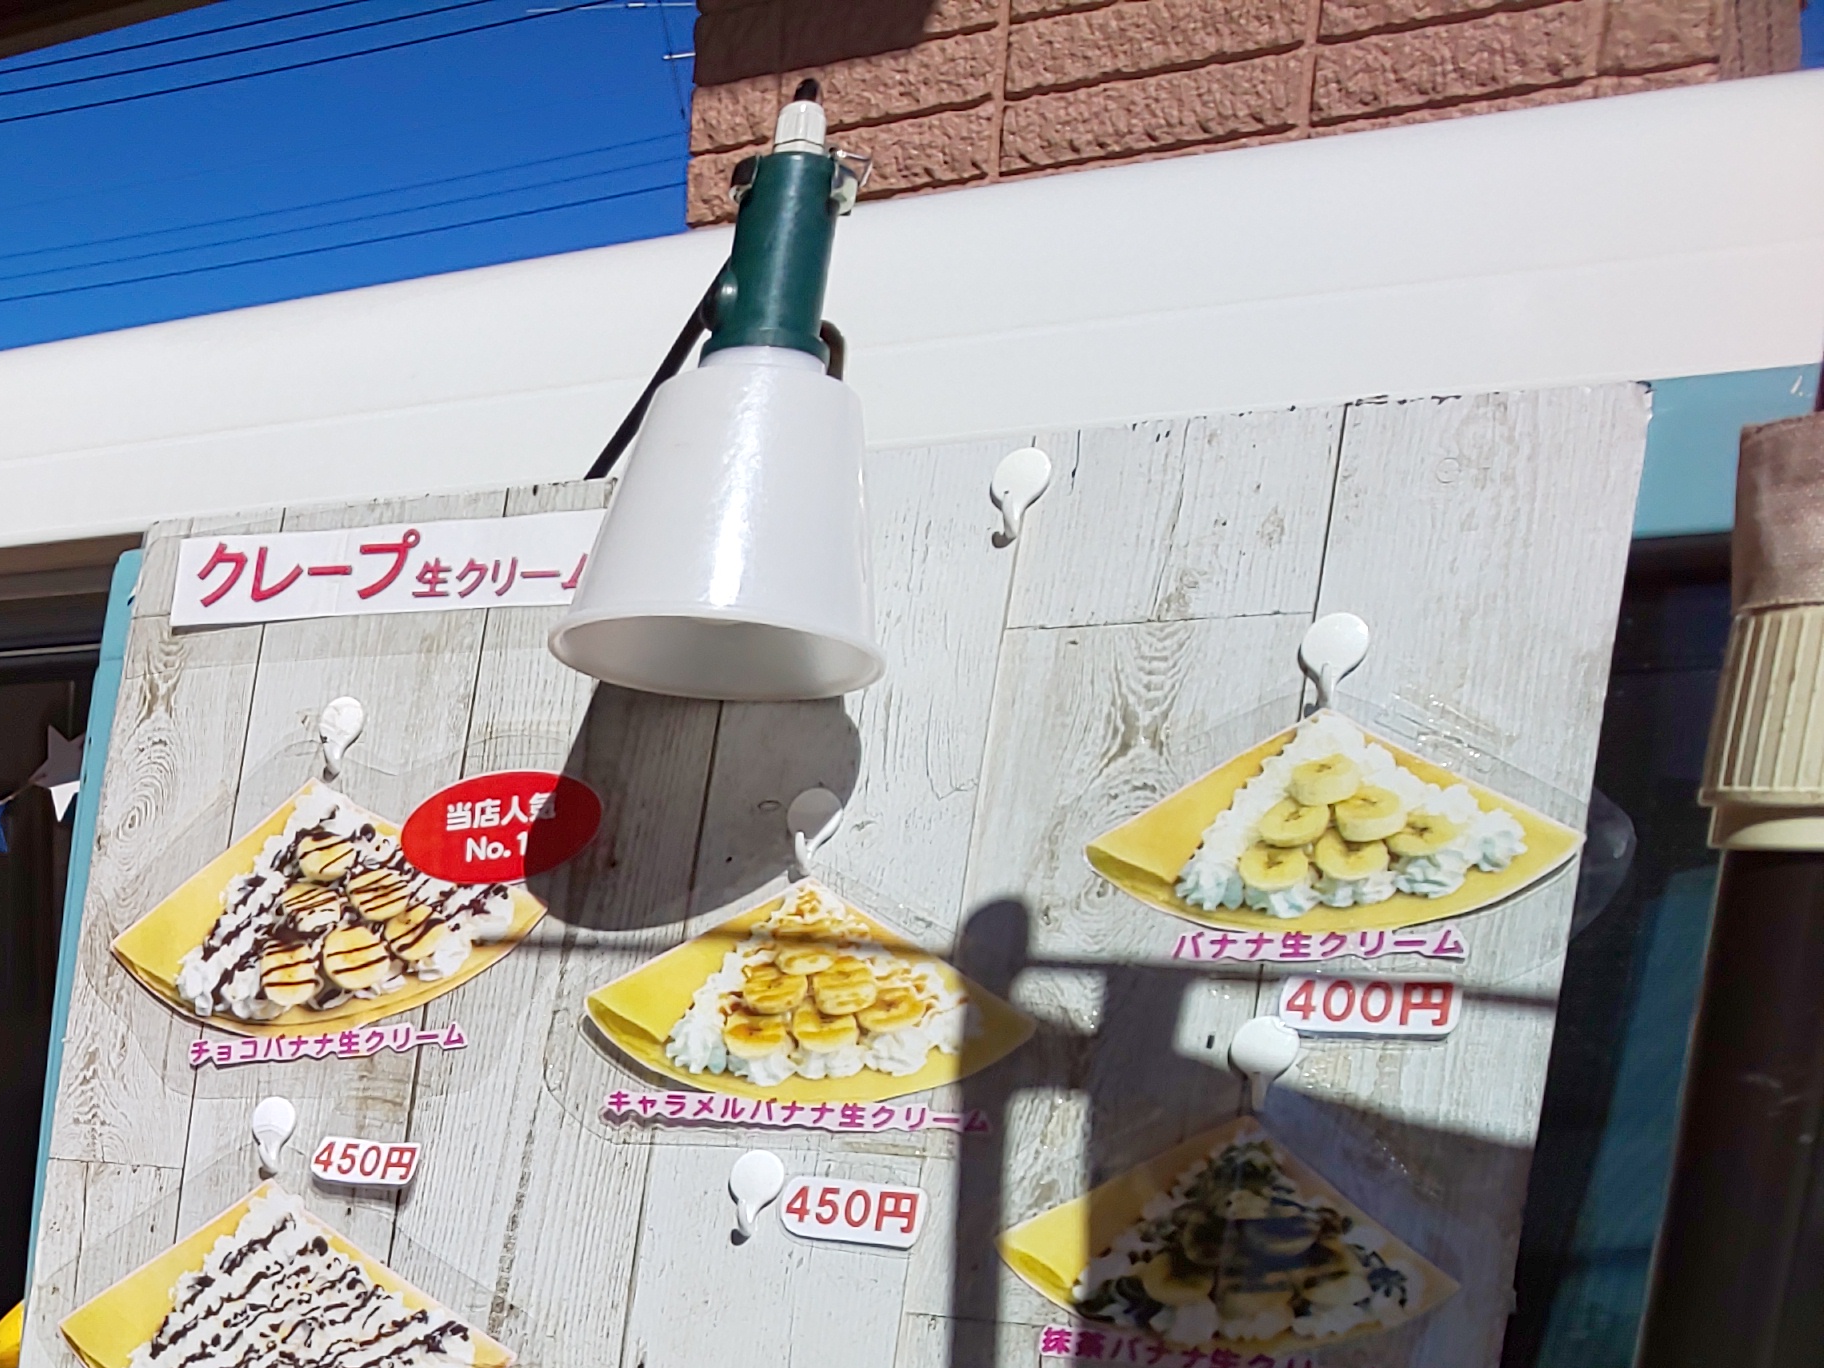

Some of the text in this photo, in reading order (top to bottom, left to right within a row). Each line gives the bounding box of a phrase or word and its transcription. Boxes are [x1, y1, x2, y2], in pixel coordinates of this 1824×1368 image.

[445, 791, 556, 831] 当店人気
[1173, 930, 1465, 960] バナナ生クリーム
[1285, 979, 1455, 1027] 400円
[190, 1023, 465, 1063] チョコバナナ生クリーム
[606, 1090, 990, 1134] キャラメルバナナ生クリーム
[313, 1141, 418, 1180] 450円
[785, 1184, 921, 1235] 450円
